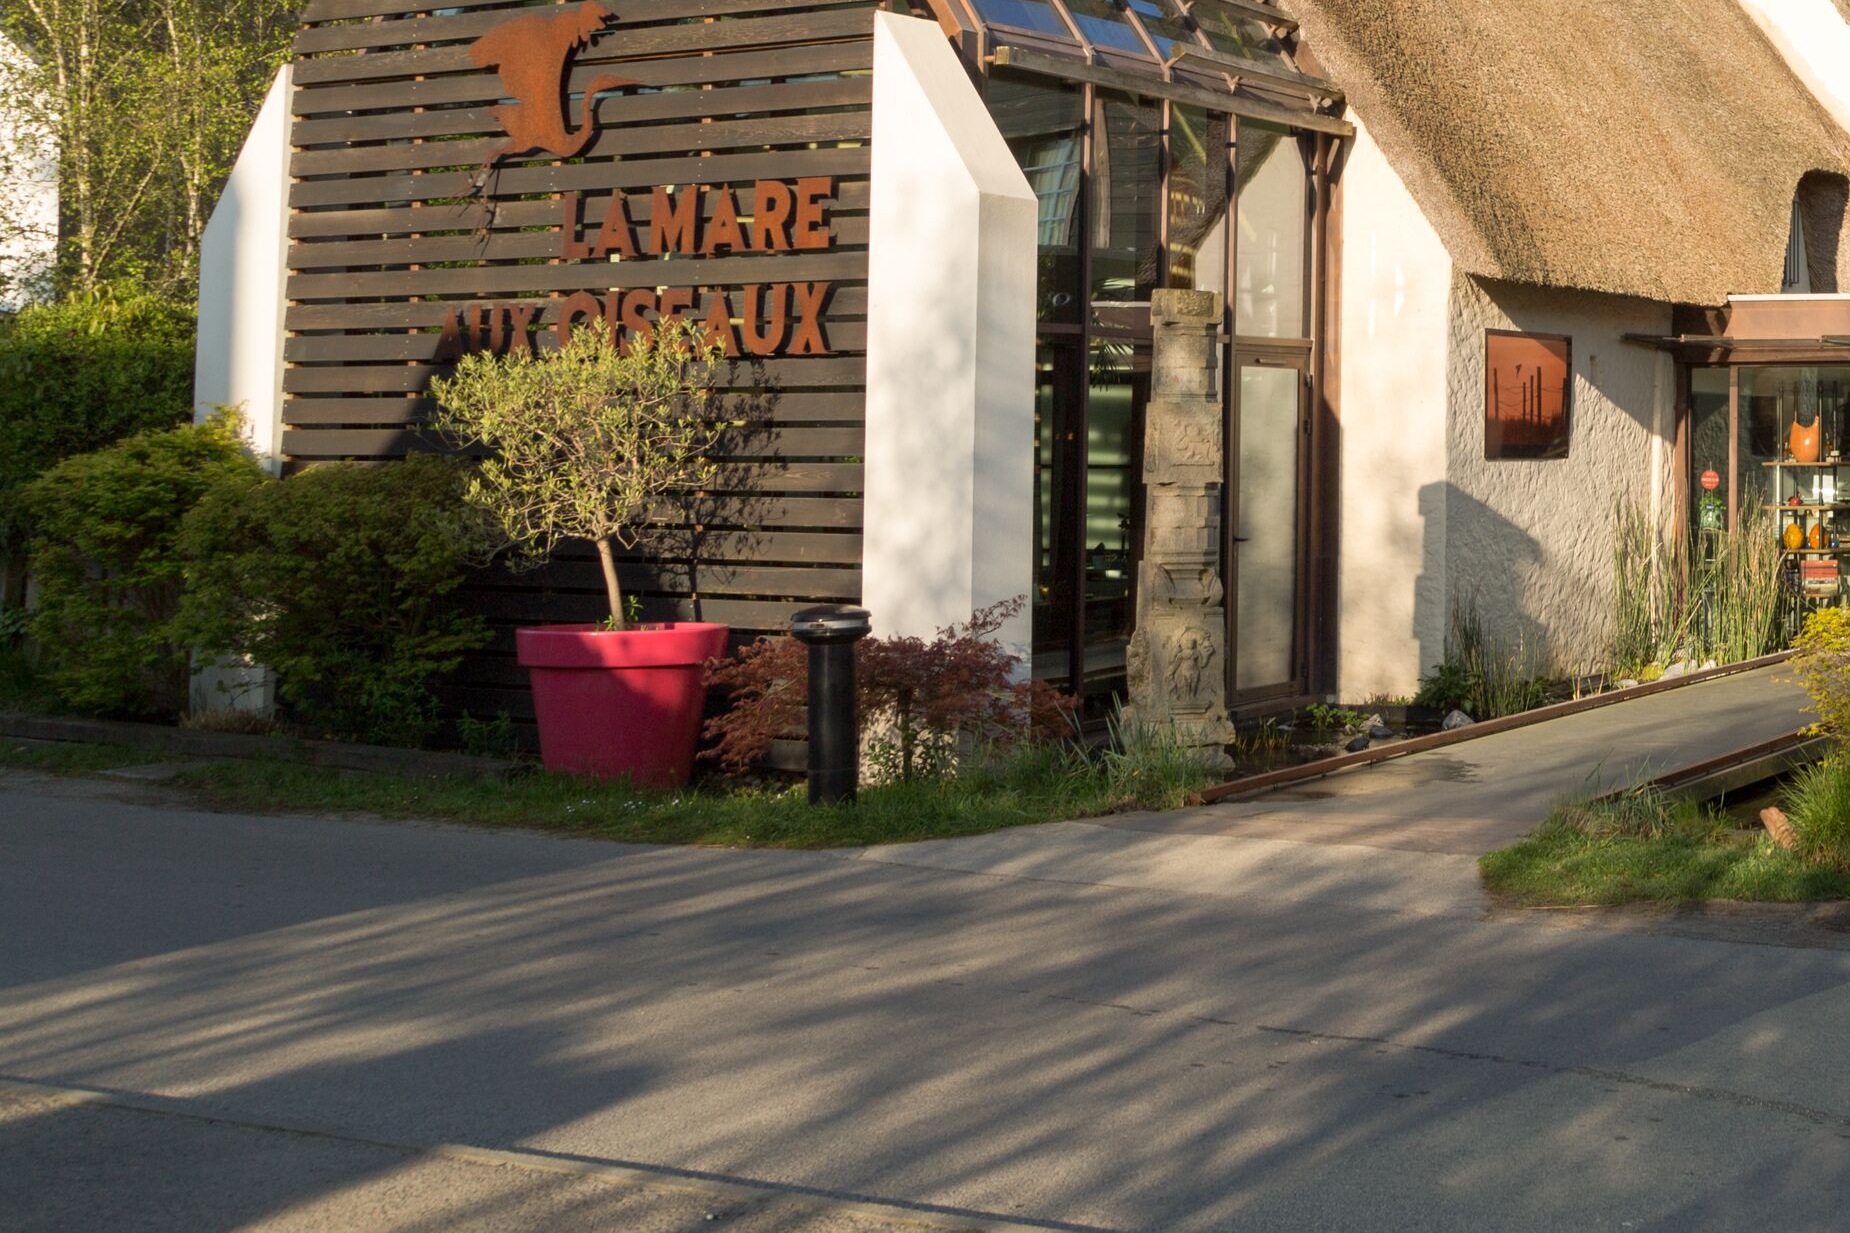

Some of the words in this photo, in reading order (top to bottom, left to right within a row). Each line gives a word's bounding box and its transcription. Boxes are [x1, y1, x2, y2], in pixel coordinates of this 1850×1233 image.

[562, 187, 637, 260] LA
[649, 177, 832, 256] MARE
[431, 302, 539, 363] AUX
[556, 282, 833, 360] OISEAUX
